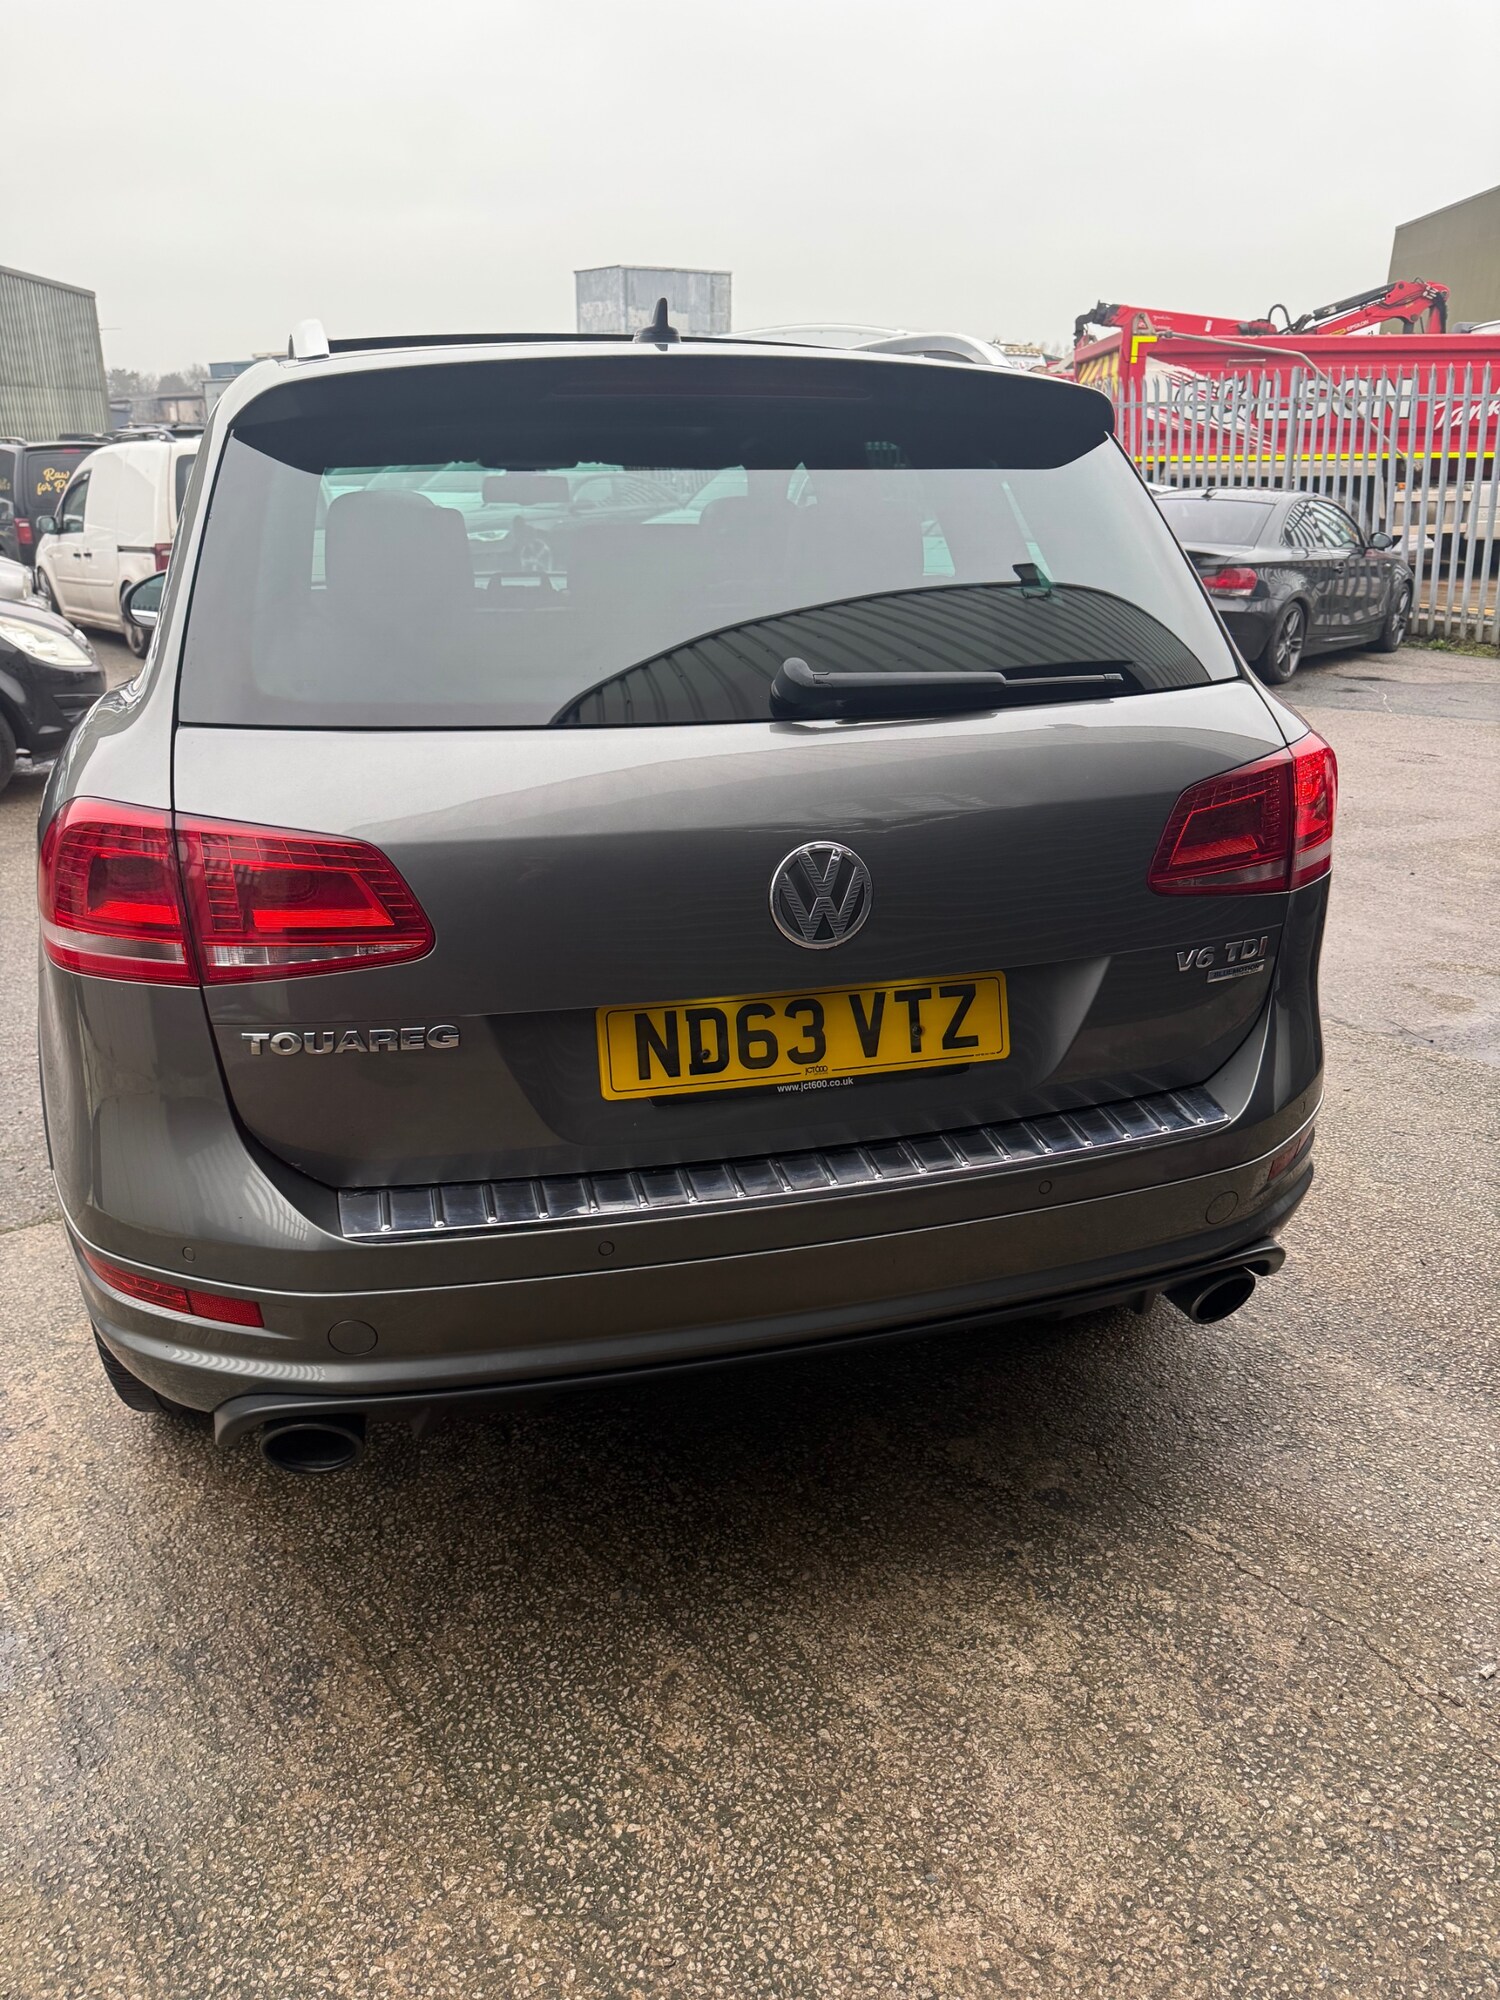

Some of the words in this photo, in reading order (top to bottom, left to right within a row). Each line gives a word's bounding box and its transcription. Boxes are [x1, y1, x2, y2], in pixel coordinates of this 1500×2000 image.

[43, 467, 70, 482] Raw
[36, 482, 53, 495] for
[54, 479, 68, 493] P
[1176, 946, 1215, 972] V6
[1225, 936, 1268, 962] TDI
[241, 1024, 460, 1056] TOUAREG
[633, 998, 827, 1081] ND63
[848, 984, 979, 1059] VTZ
[776, 1077, 854, 1092] www.jct600.co.uk
